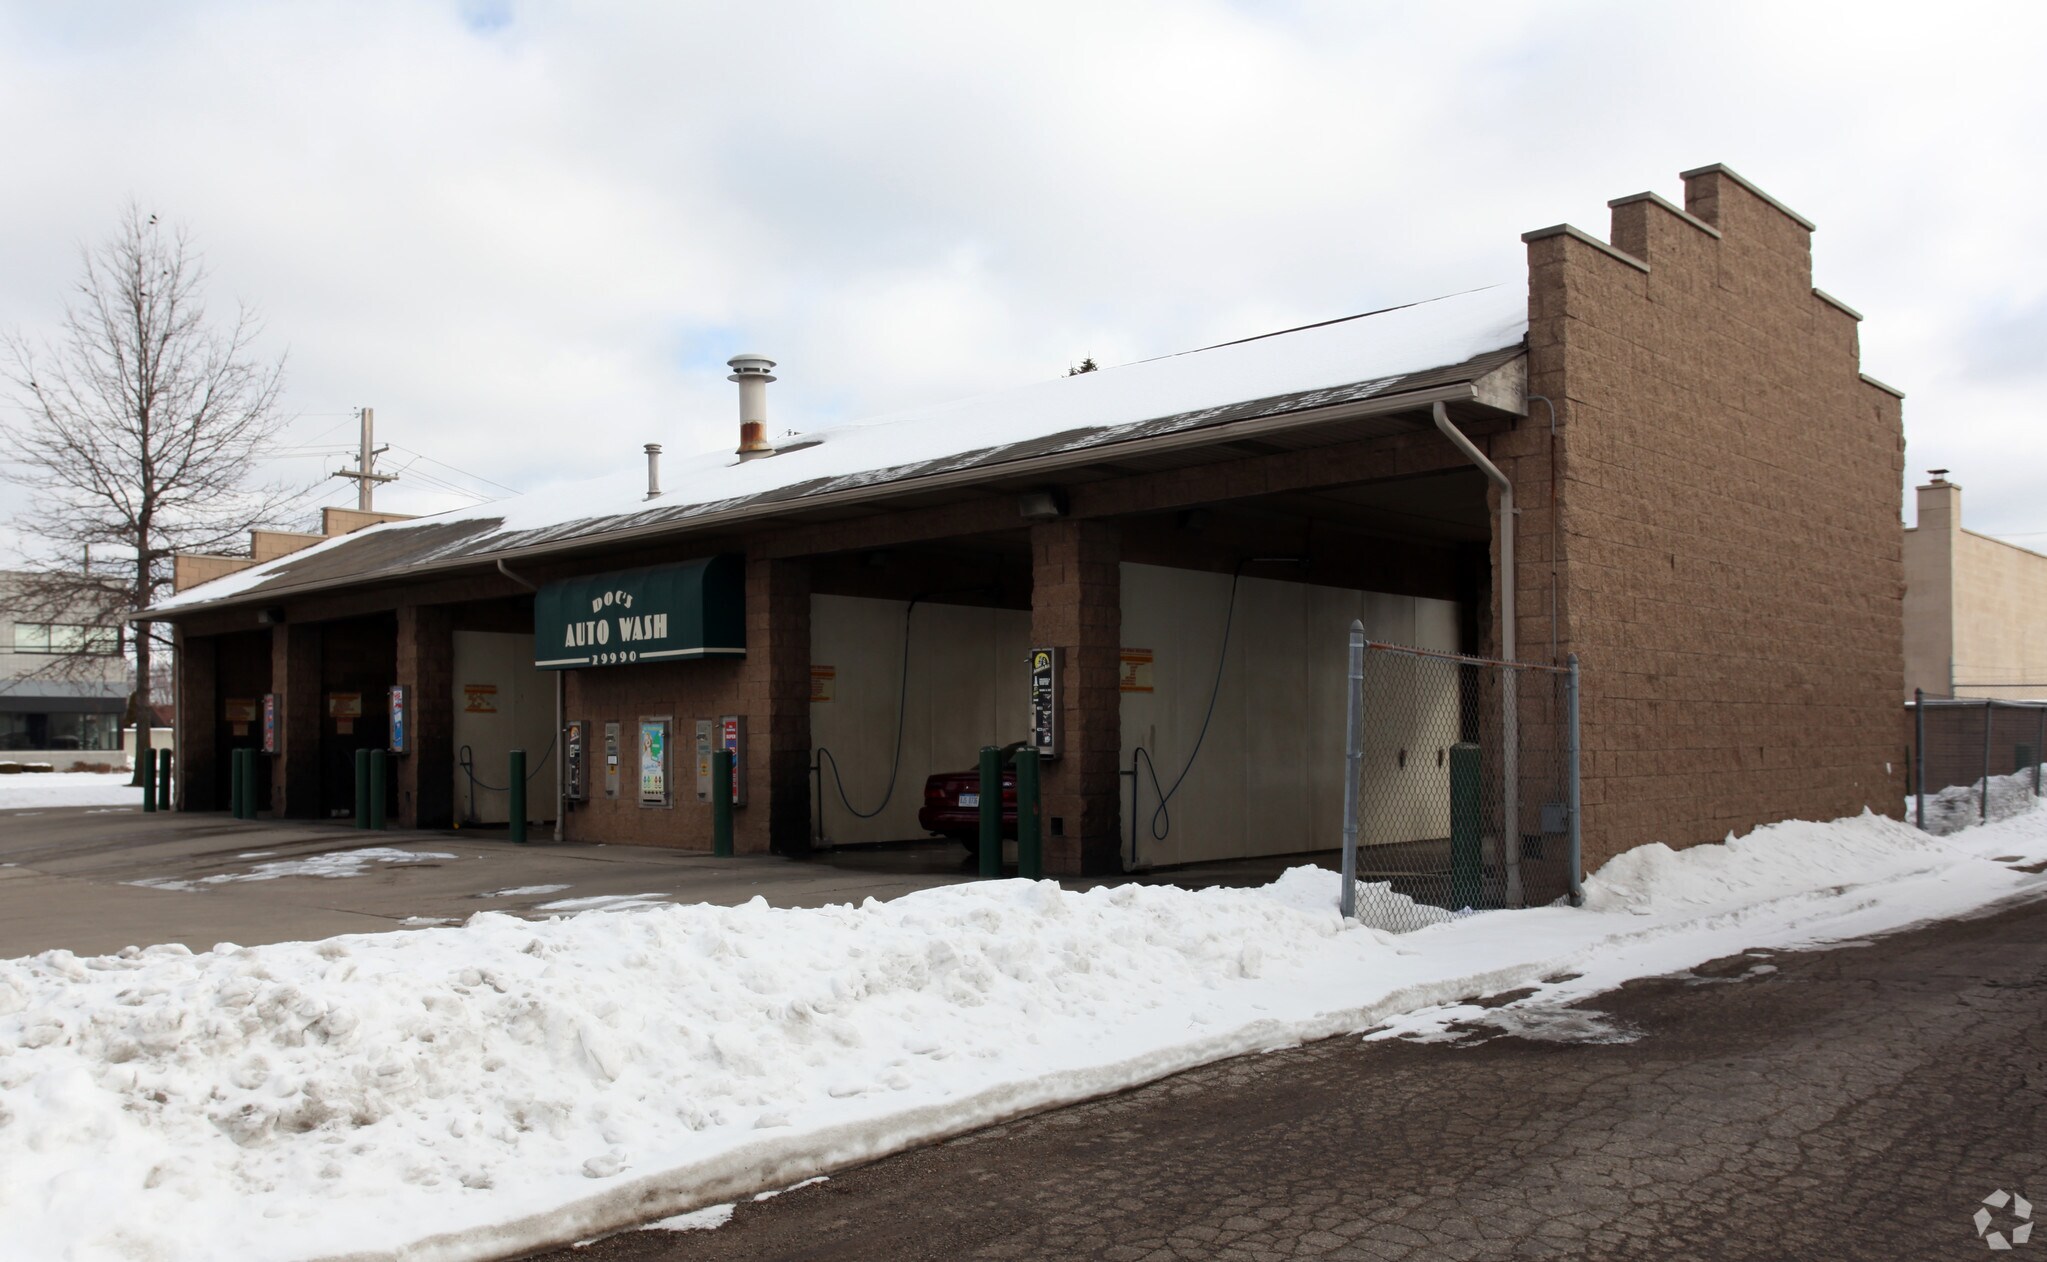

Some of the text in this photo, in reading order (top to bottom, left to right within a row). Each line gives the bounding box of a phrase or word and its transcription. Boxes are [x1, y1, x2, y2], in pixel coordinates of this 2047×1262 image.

[592, 590, 633, 613] DOC'S
[565, 613, 668, 647] AUTO WASH
[592, 650, 637, 666] 29990
